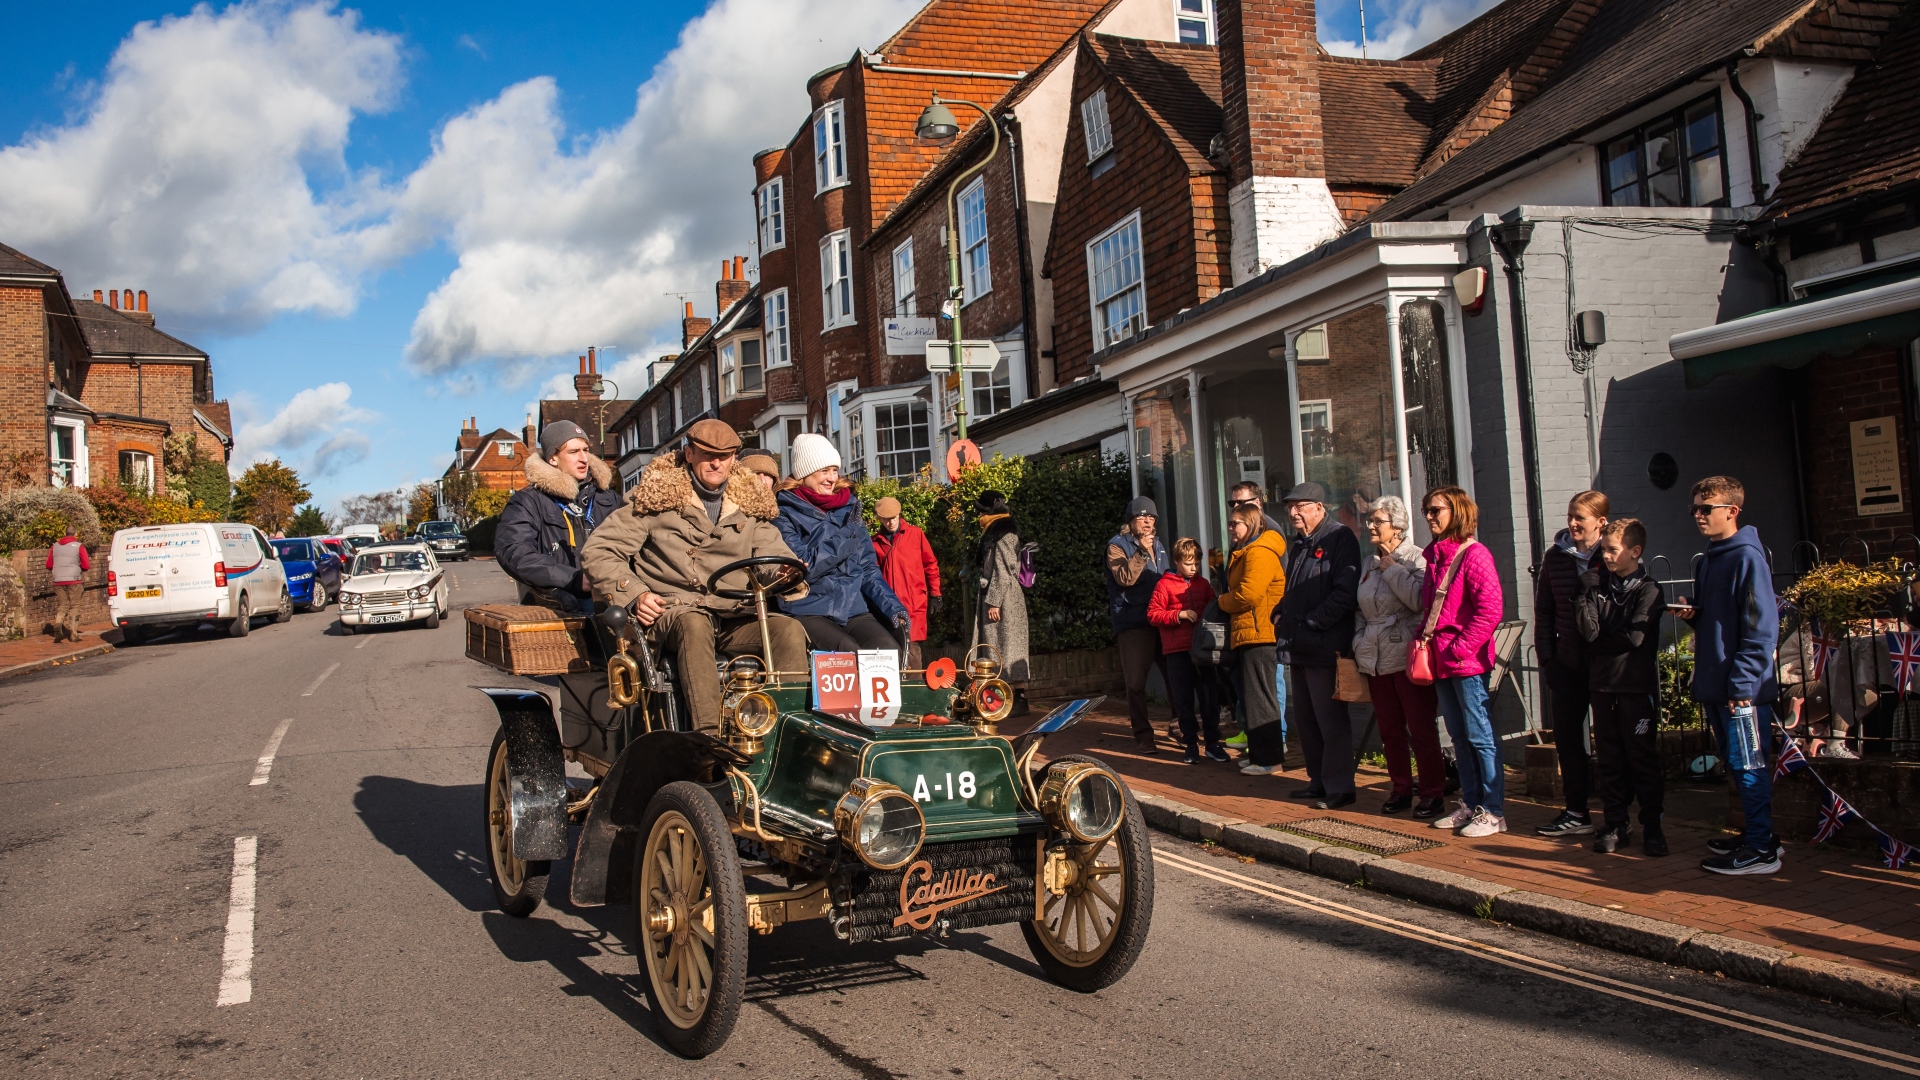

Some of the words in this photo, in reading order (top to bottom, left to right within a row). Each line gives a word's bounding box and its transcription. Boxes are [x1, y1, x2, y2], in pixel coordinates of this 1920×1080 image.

[126, 540, 200, 550] Grouptyre
[821, 673, 856, 693] 307
[871, 677, 890, 703] R
[913, 771, 977, 803] A-18
[893, 860, 1008, 931] Cadillac
